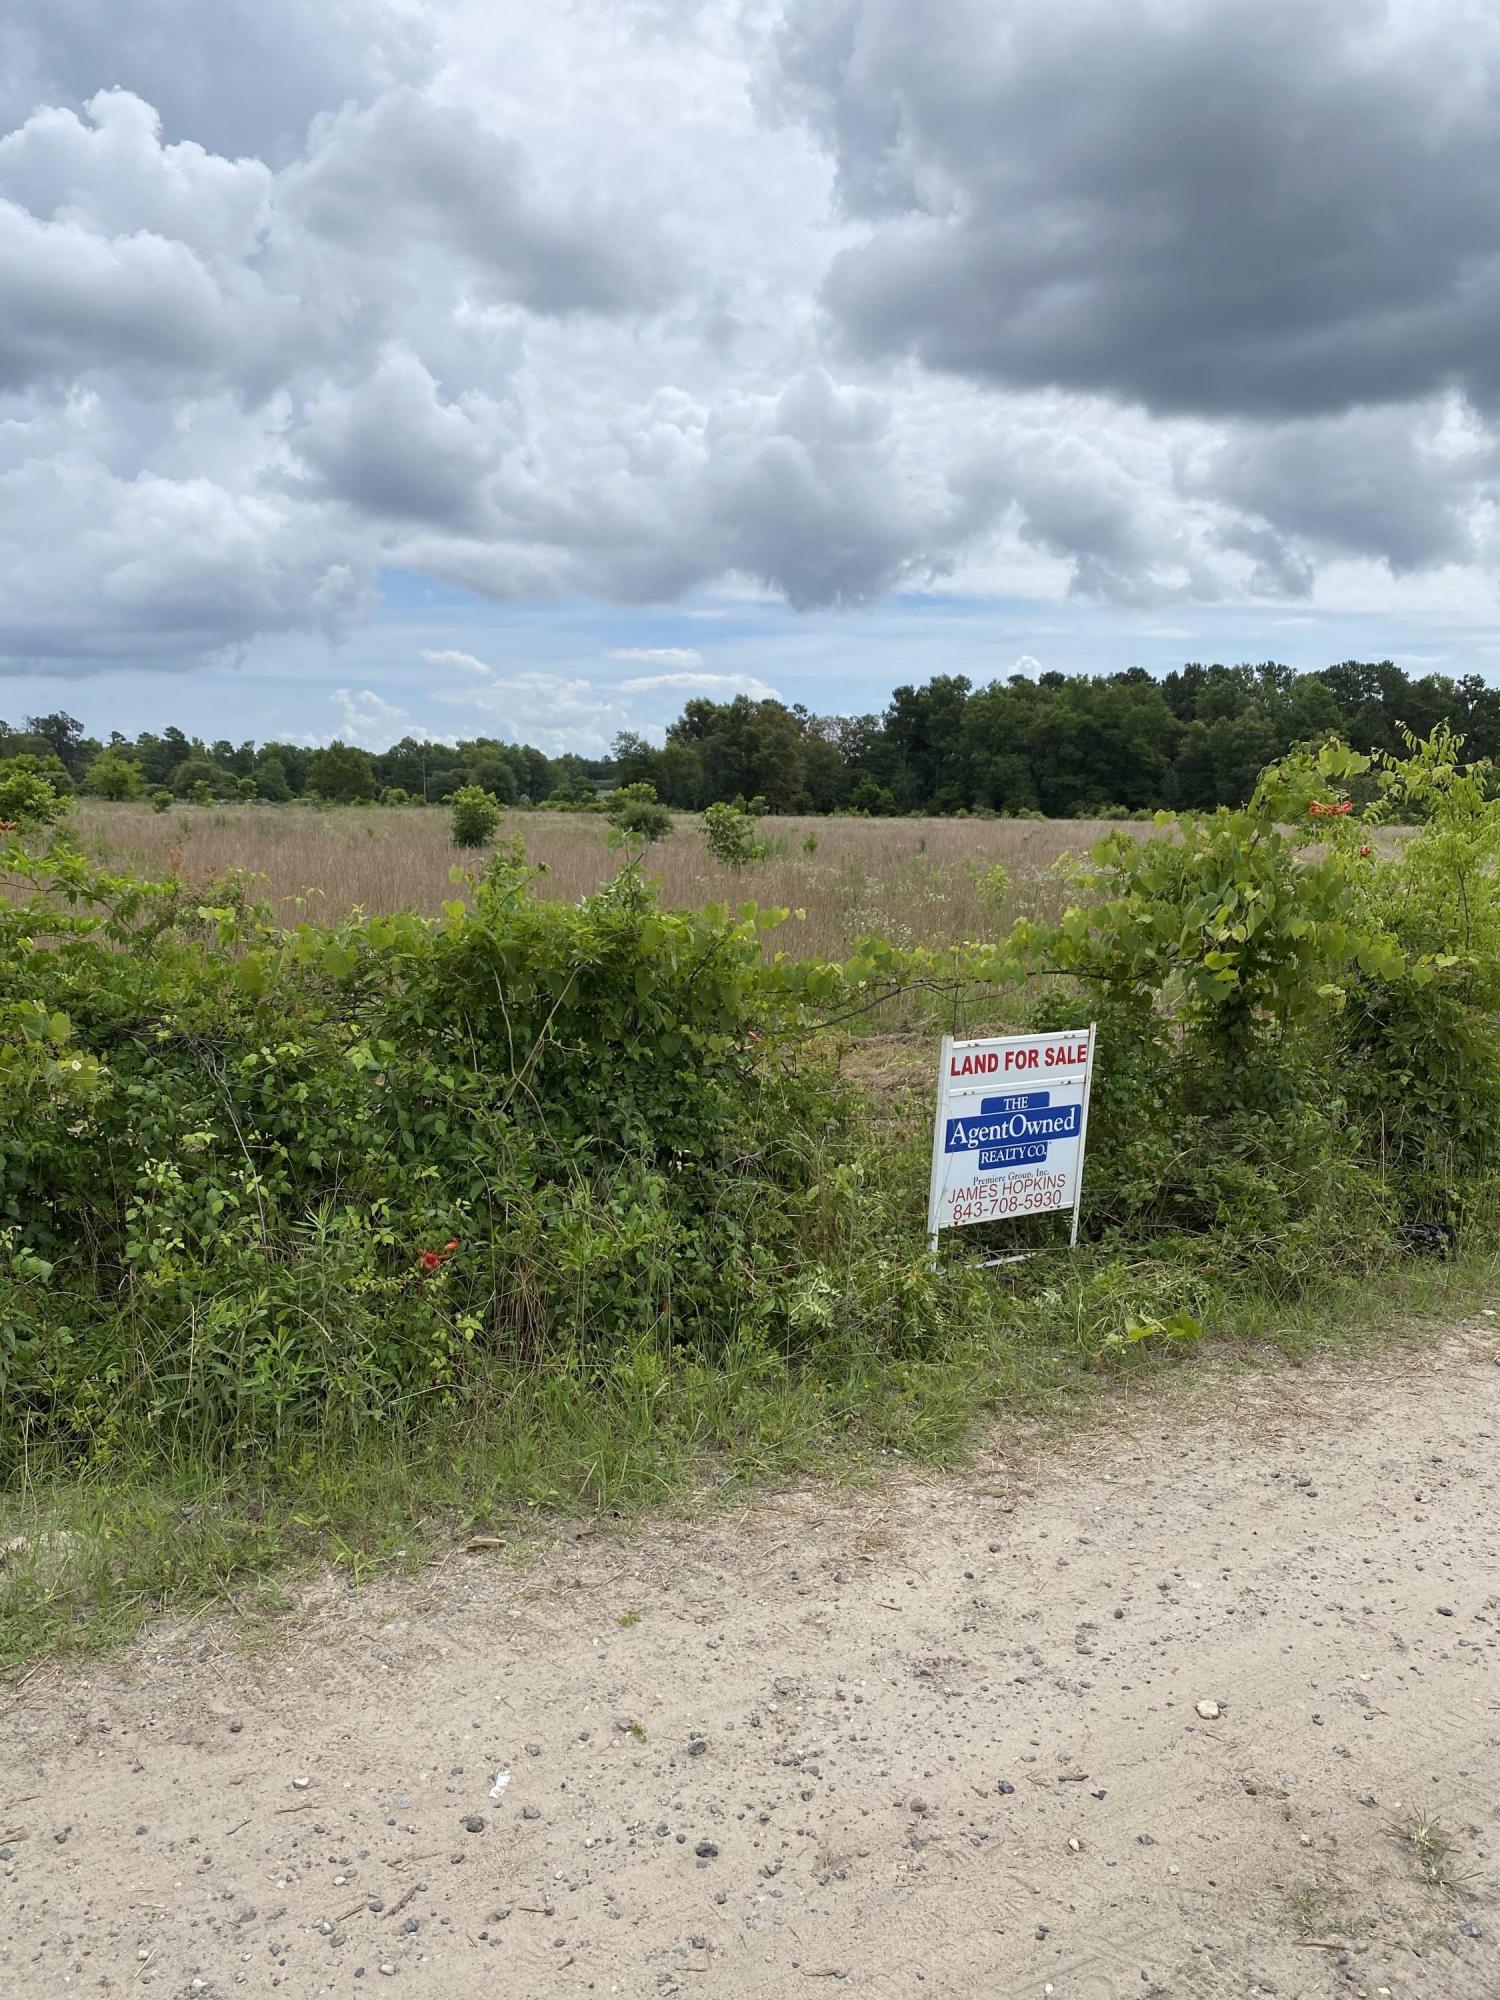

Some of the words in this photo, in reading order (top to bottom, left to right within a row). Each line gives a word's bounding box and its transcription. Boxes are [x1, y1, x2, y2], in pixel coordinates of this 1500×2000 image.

[950, 1053, 999, 1077] LAND
[1004, 1049, 1039, 1071] FOR
[1044, 1044, 1087, 1067] SALE
[1003, 1096, 1029, 1111] THE
[949, 1107, 1075, 1148] AgentOwned
[980, 1146, 1027, 1164] REALTY
[948, 1184, 998, 1204] JAMES
[1002, 1174, 1066, 1196] HOPKINS
[973, 1175, 1006, 1185] Premiere
[953, 1190, 1062, 1220] 843-708-5930
